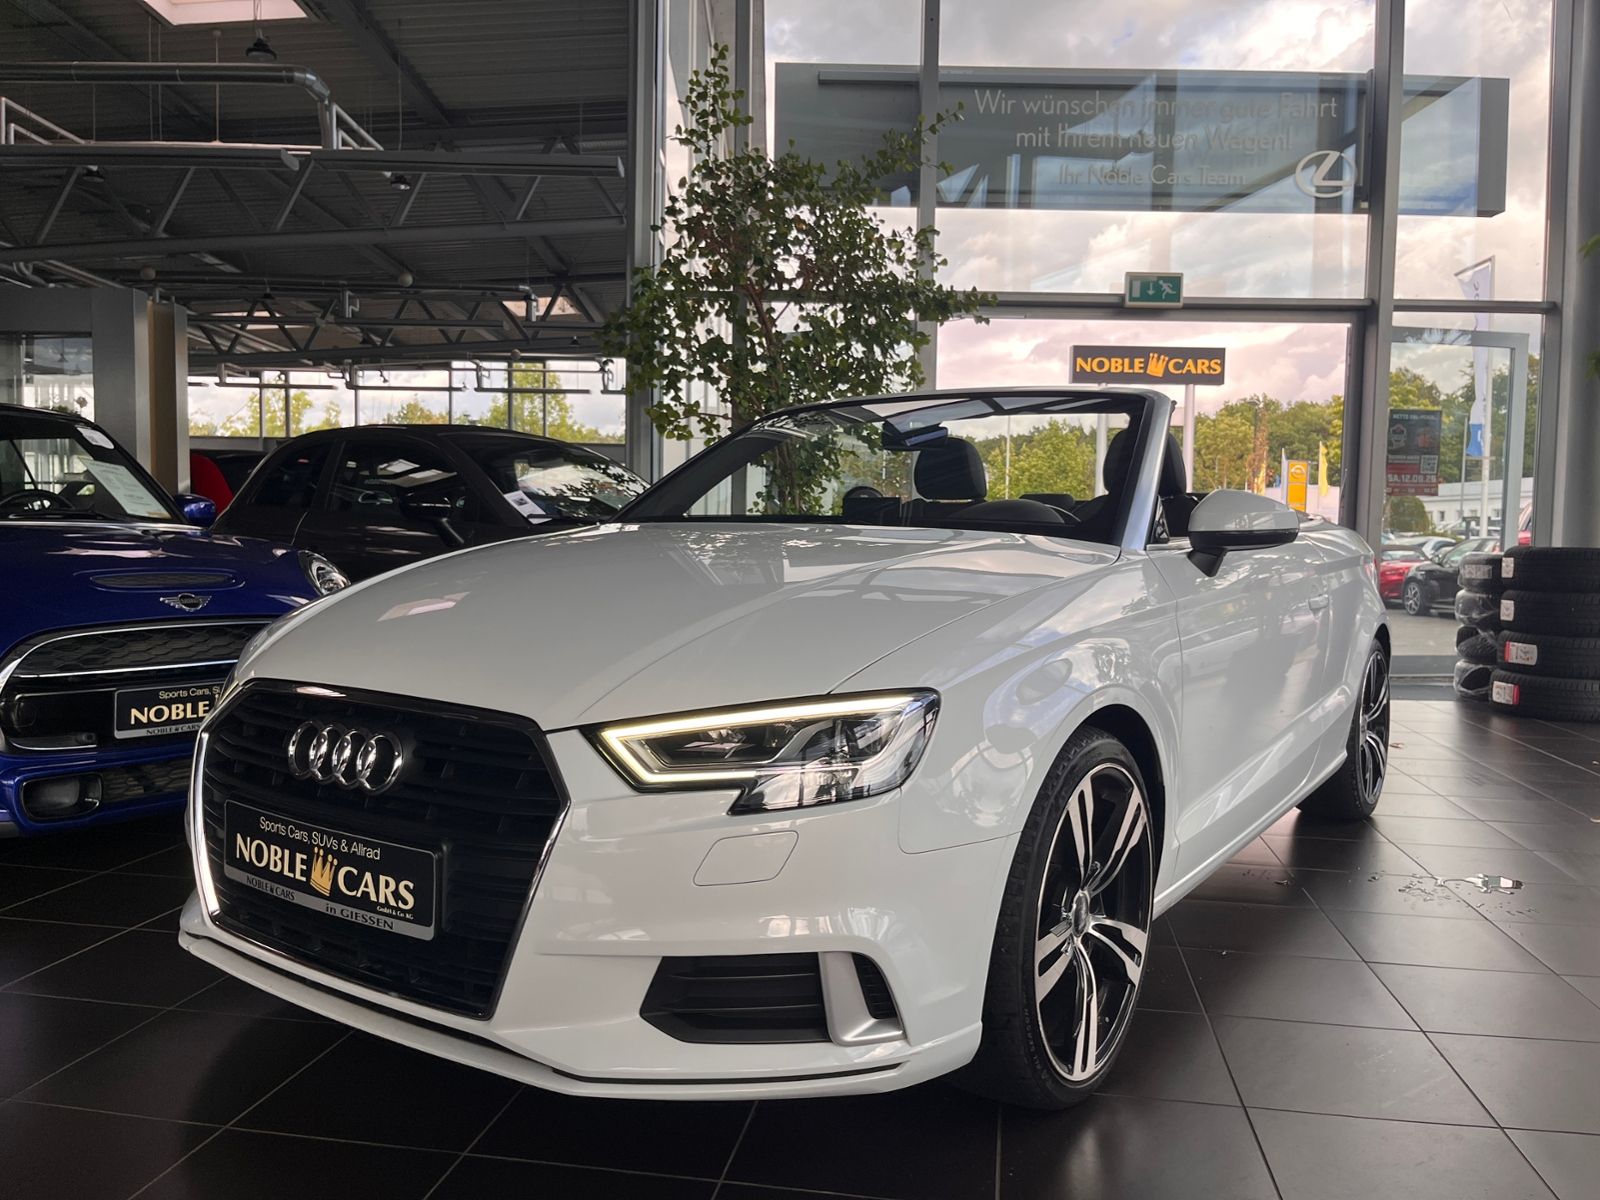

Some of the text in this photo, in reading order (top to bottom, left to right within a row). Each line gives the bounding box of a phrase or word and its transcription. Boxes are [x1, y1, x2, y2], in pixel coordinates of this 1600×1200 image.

[974, 89, 1338, 124] Wir wünschen immer gute Fahrt
[1015, 123, 1293, 155] mit Ihrem neuen Wagen!
[1059, 163, 1247, 186] Ihr Noble Cars Team
[1075, 356, 1222, 375] NOBLE CARS
[159, 689, 188, 699] Sports
[189, 688, 212, 697] Cars,
[130, 701, 210, 725] NOBLE
[146, 727, 172, 735] NOBLE
[259, 816, 381, 861] Sports Cars, SUVs & Allrad
[236, 832, 415, 911] NOBLE CARS
[246, 875, 296, 902] NOBLE CARS
[325, 903, 394, 931] in GIESSEN
